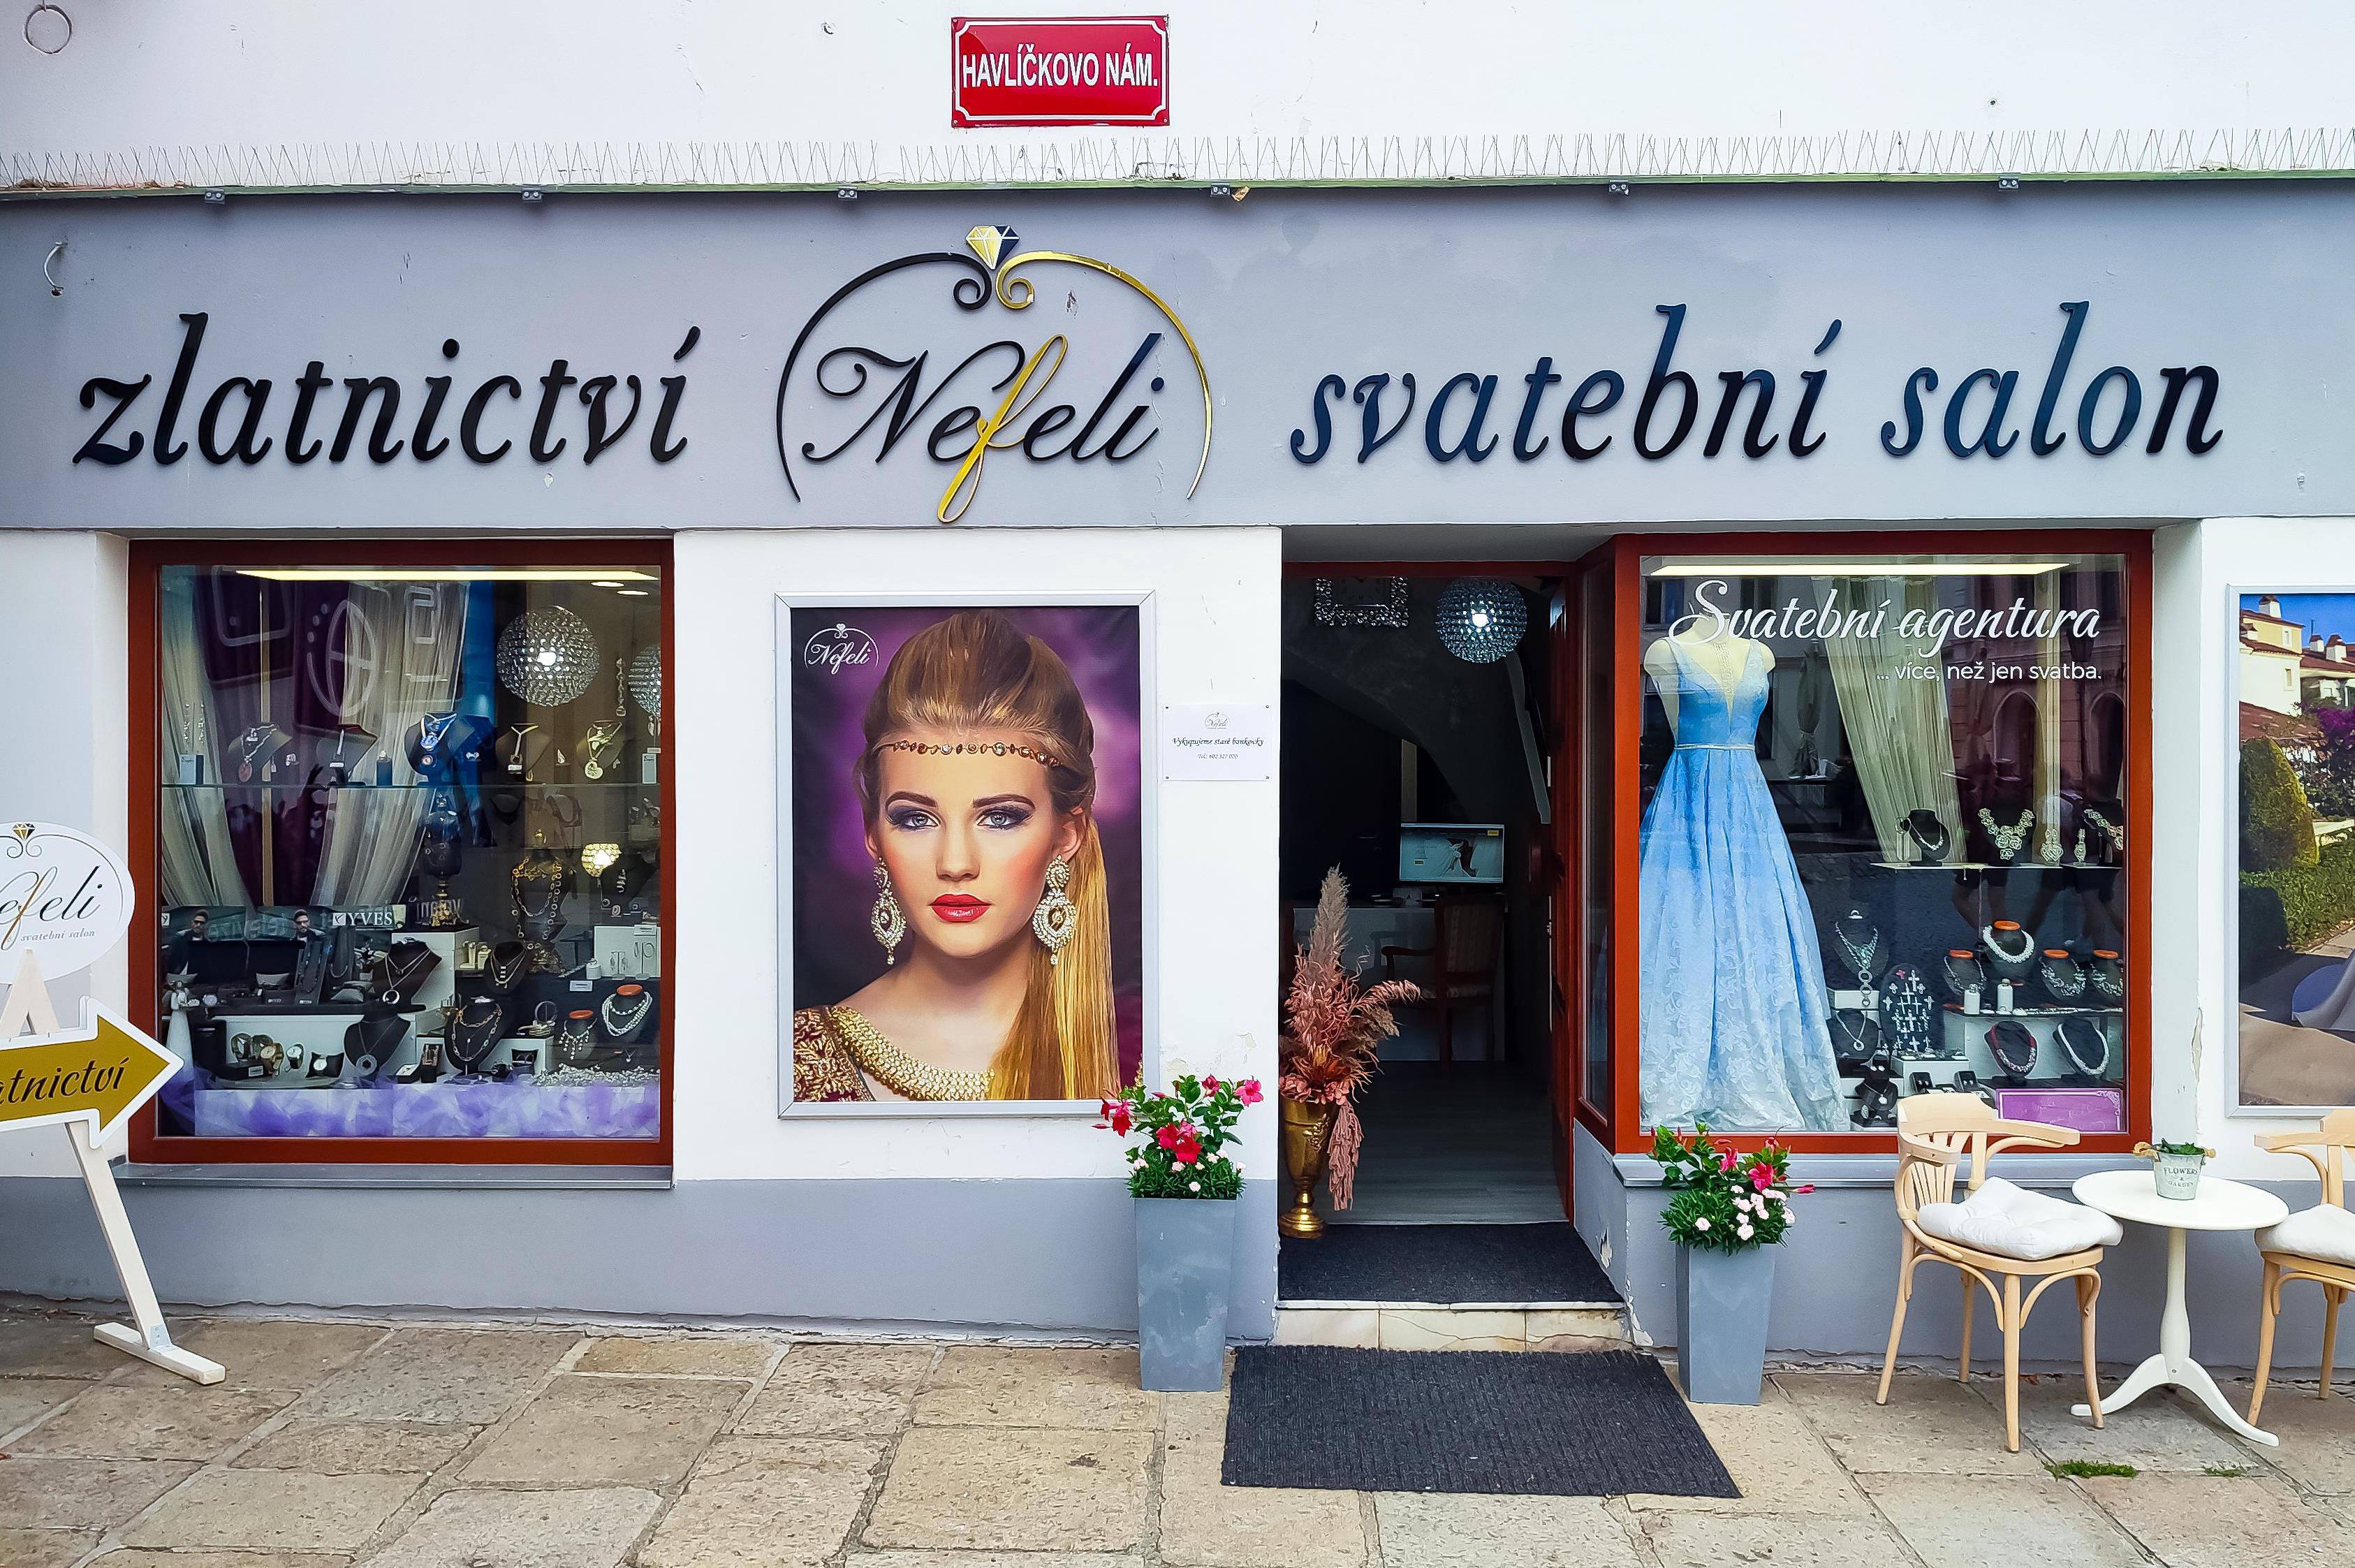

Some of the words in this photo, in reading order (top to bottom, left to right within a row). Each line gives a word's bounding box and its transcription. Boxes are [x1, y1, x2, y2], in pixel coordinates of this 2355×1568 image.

[962, 43, 1100, 87] HAVLÍČKOVO
[1105, 43, 1159, 87] NÁM.
[73, 312, 701, 466] zlatnictví
[1290, 302, 1844, 464] svatební
[1880, 300, 2224, 458] salon
[801, 332, 1164, 525] Nefeli
[1668, 580, 1891, 645] Svatební
[1898, 597, 2100, 658] agentura
[807, 640, 873, 675] Nefeli
[1895, 662, 1940, 682] více,
[1947, 661, 1986, 680] než
[1988, 662, 2023, 683] jen
[2028, 661, 2102, 680] svatba.
[347, 912, 392, 926] YVES
